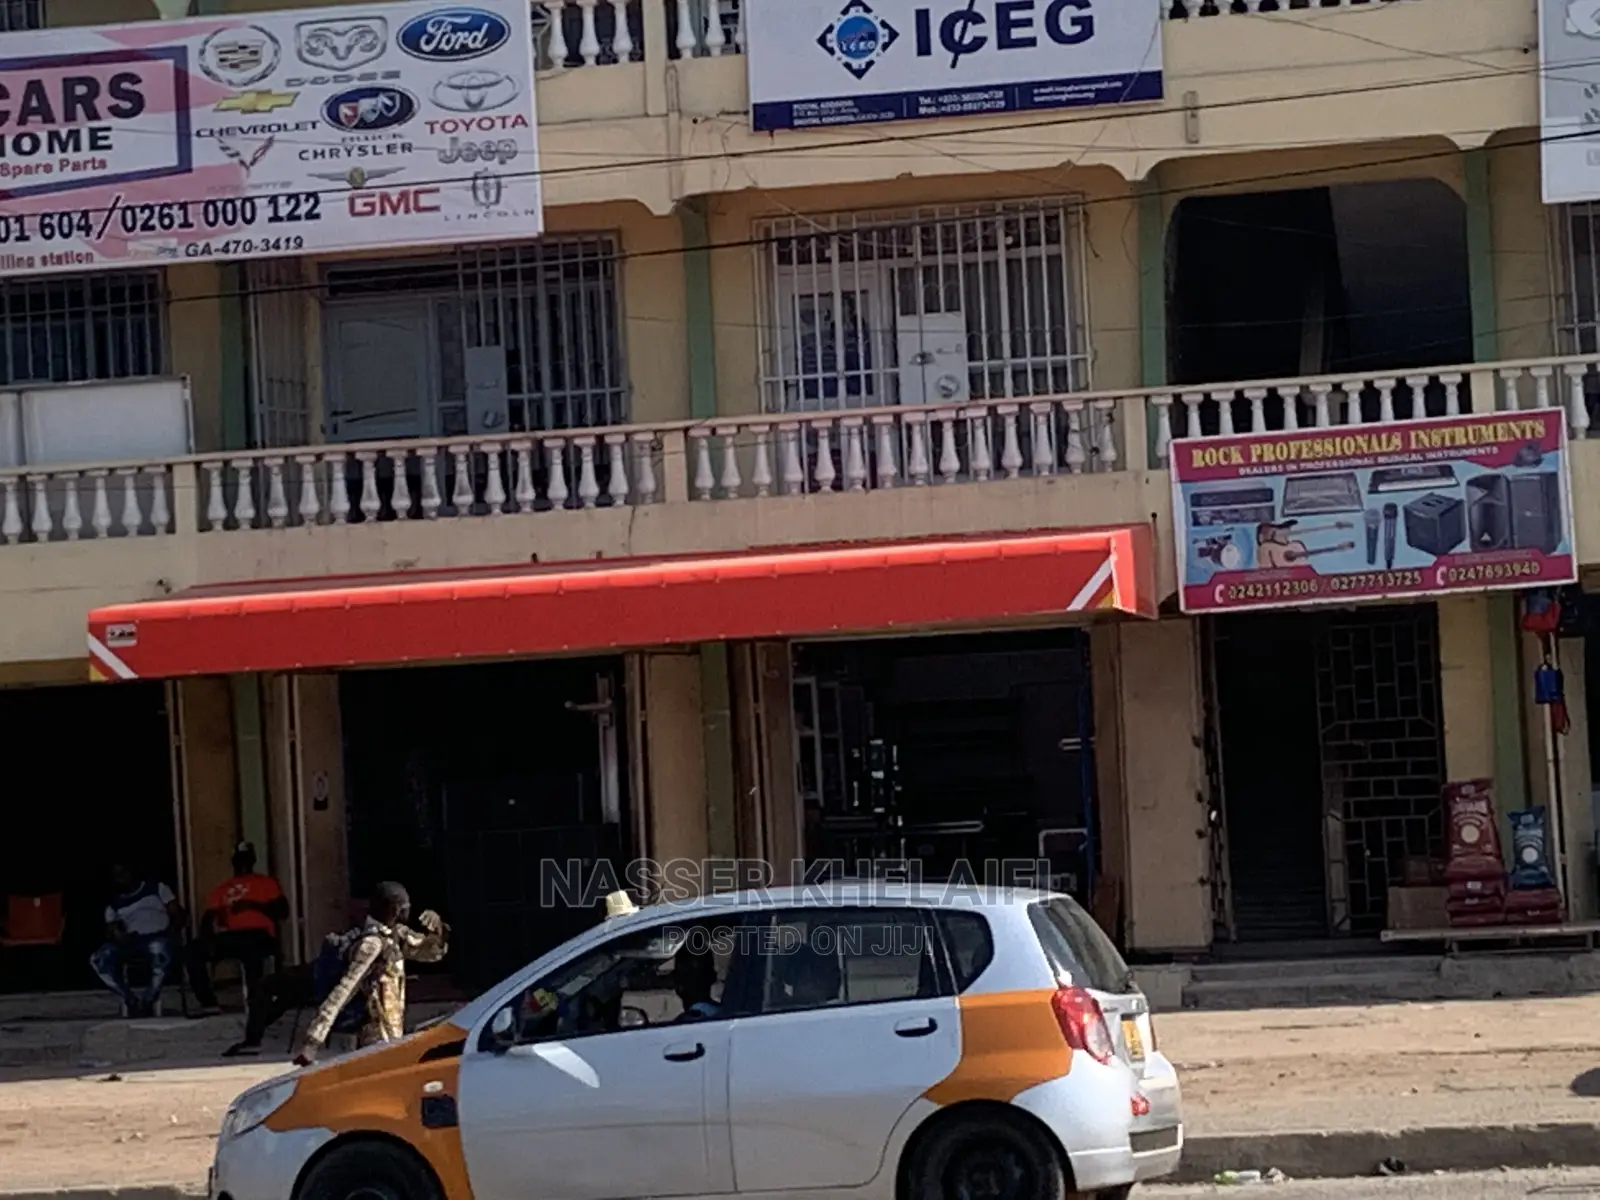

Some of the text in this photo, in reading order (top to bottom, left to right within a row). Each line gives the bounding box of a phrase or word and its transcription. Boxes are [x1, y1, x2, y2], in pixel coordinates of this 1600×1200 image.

[420, 15, 489, 52] Ford
[0, 72, 145, 128] ARS
[195, 120, 320, 138] CHEVROLET
[424, 114, 528, 135] TOYOTA
[0, 126, 113, 158] OME
[298, 142, 413, 161] CHRYSLER
[437, 136, 519, 165] Jeep
[0, 156, 108, 178] Spare Parts
[203, 198, 257, 228] 000
[267, 192, 322, 223] 122
[348, 187, 441, 217] GMC
[444, 208, 535, 222] LINCOLN
[41, 249, 95, 267] station
[185, 236, 304, 257] GA-470-3419
[1191, 419, 1546, 468] ROCK PROFESSIONALS INSTRUMENTS
